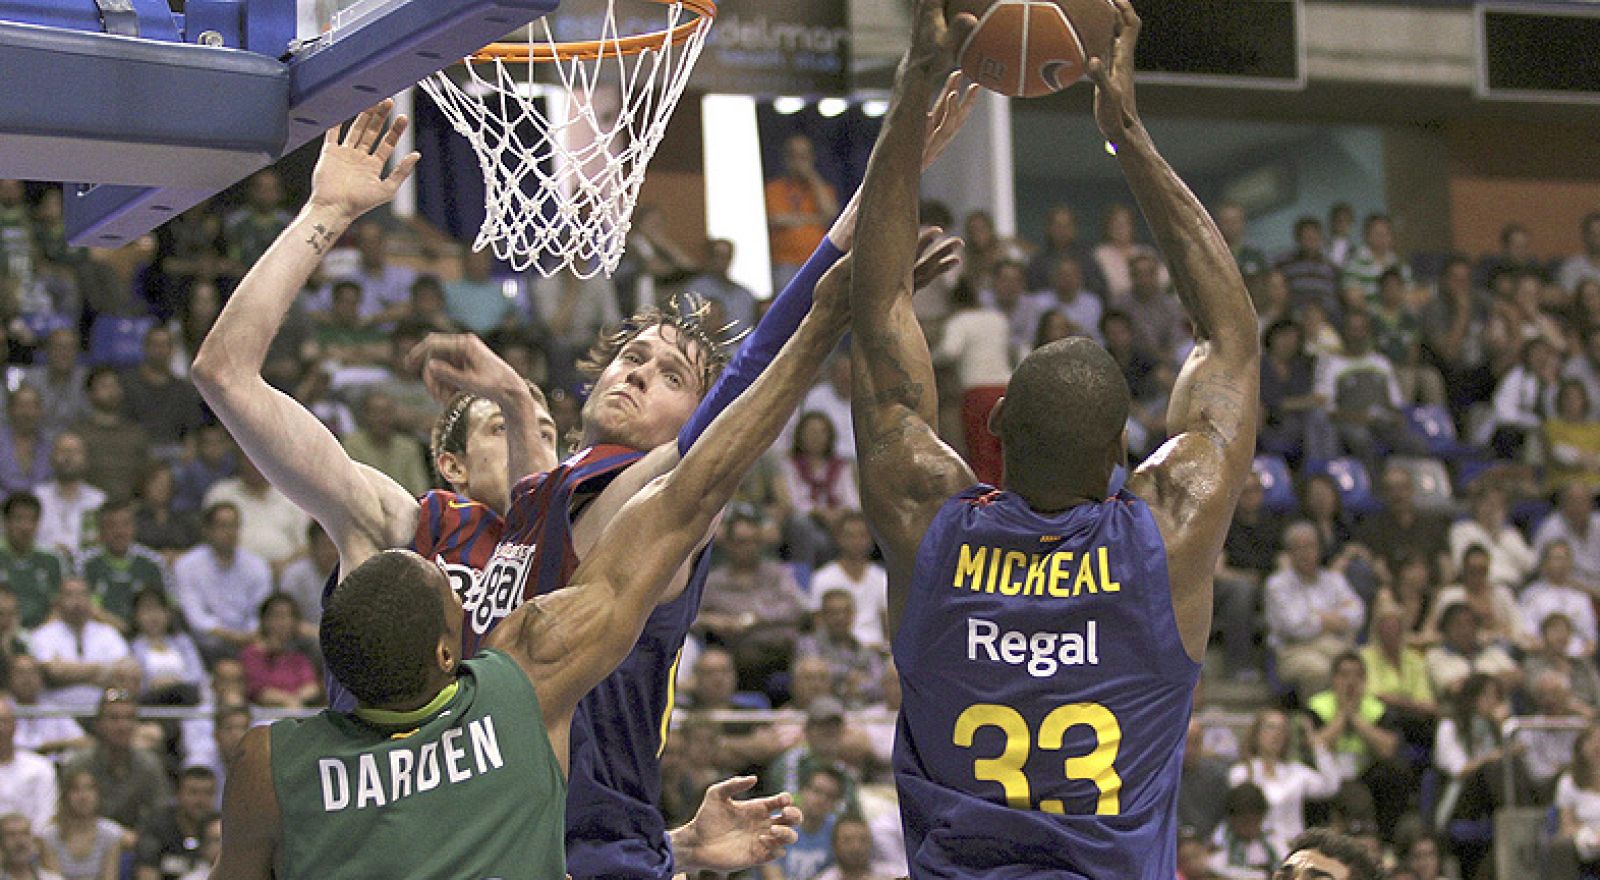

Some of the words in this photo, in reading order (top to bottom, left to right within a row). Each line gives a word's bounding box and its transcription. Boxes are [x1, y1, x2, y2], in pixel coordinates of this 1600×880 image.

[953, 544, 1121, 597] MICKEAL
[968, 617, 1098, 677] Regal
[319, 715, 503, 811] DARDEN
[953, 702, 1122, 815] 33
